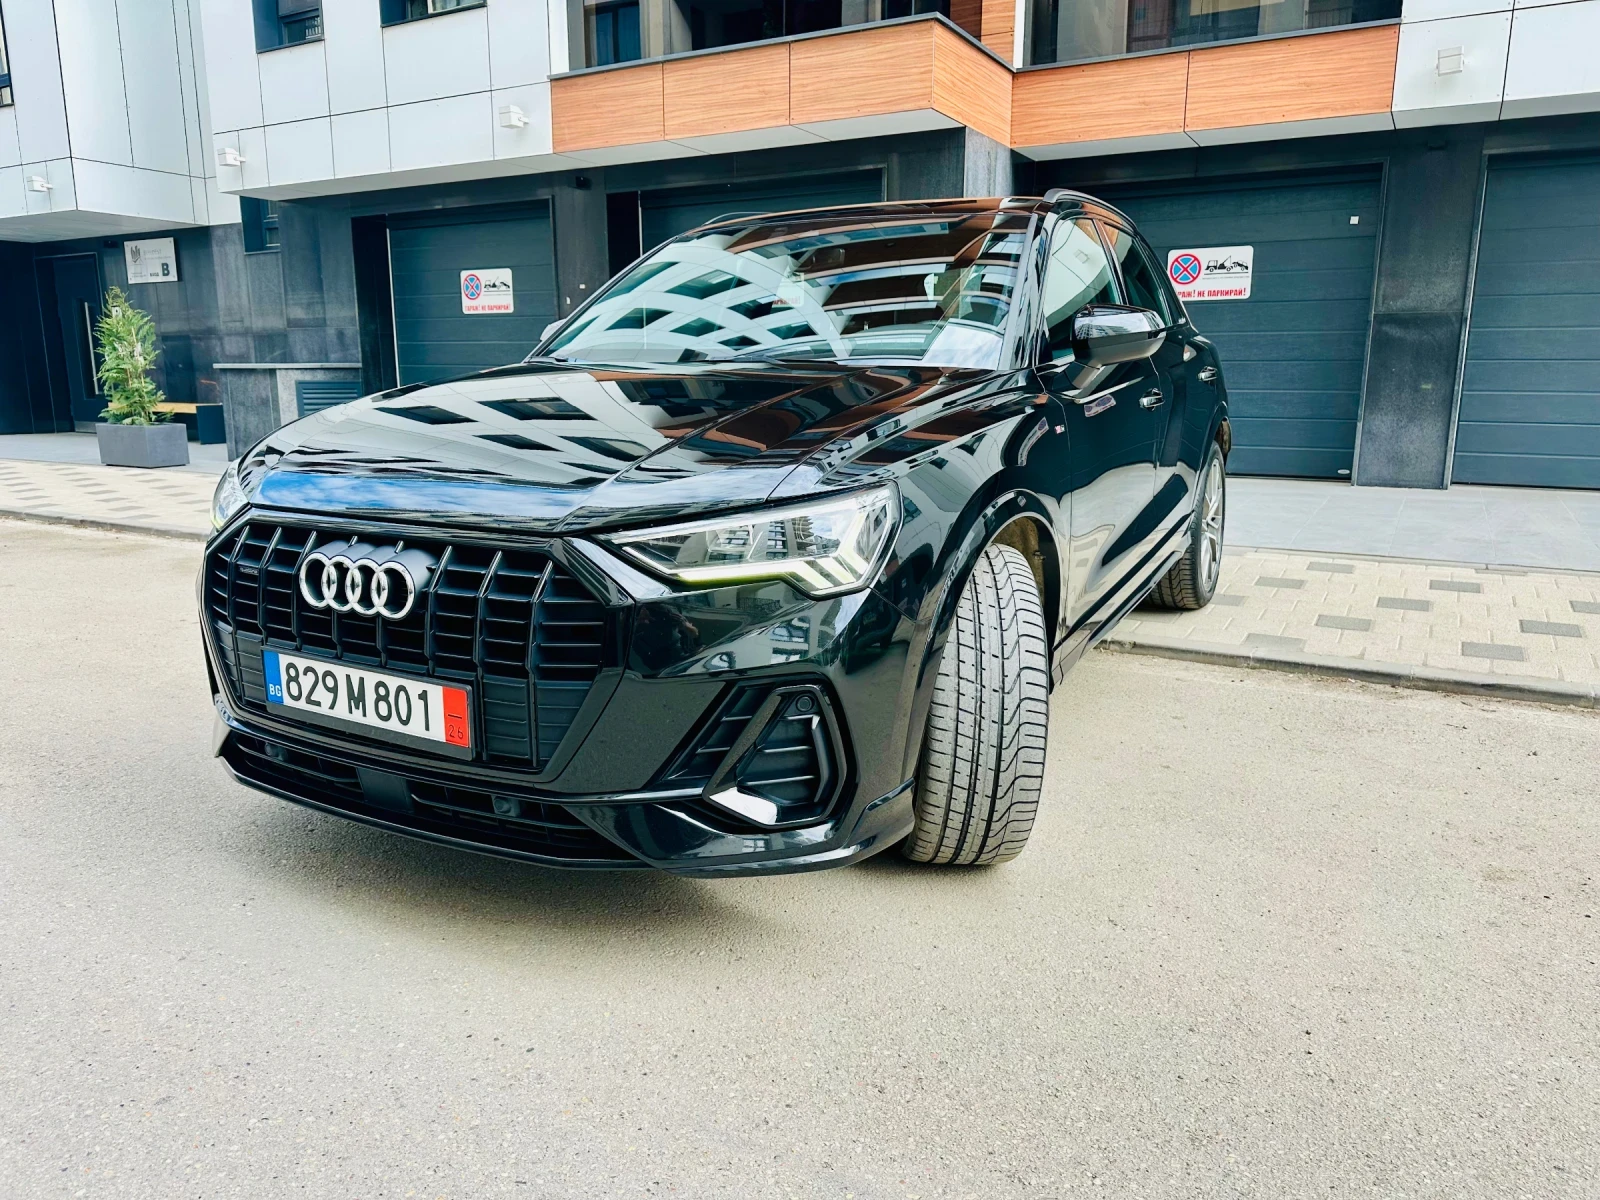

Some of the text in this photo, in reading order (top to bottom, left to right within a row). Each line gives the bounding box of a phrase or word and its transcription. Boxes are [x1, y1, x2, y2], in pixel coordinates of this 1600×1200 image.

[1177, 287, 1247, 298] РАЖ! НЕ ПАРКИРАЙ!
[269, 683, 282, 697] BG
[285, 662, 431, 732] 829 M 801
[448, 724, 464, 740] 26
